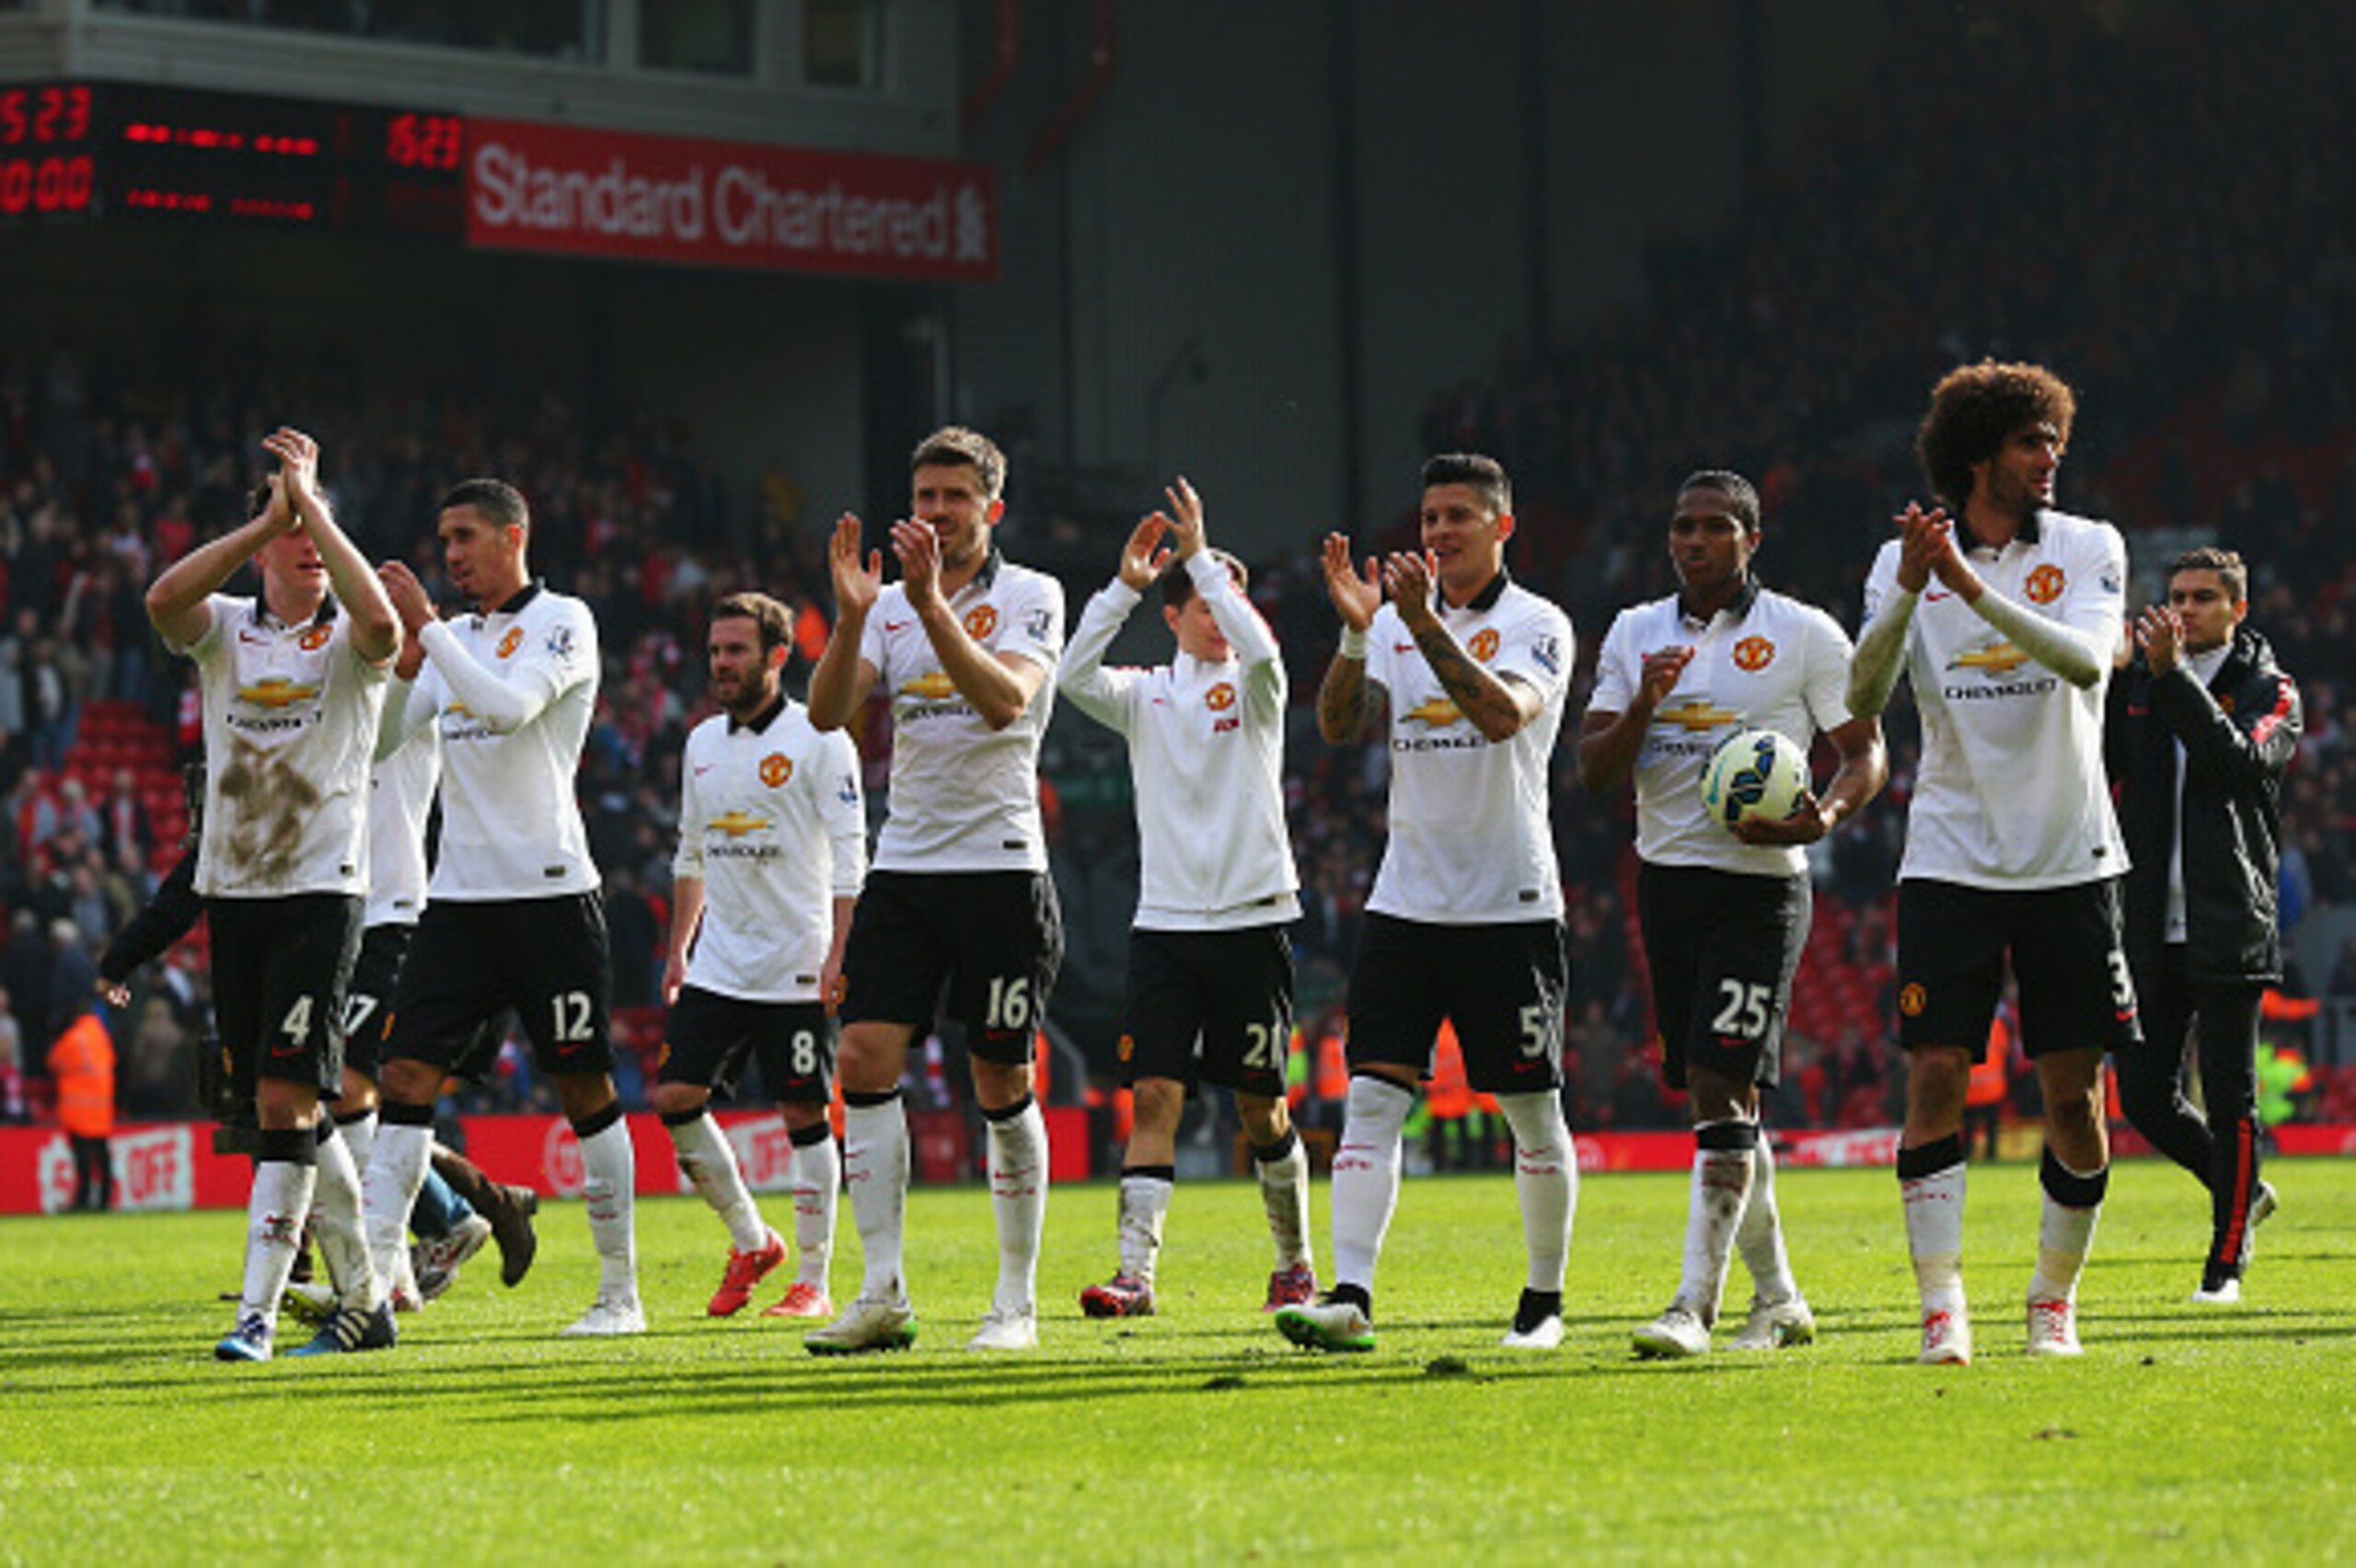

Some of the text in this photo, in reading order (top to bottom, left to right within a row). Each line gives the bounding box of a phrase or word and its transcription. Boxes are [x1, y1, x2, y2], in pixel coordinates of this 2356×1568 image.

[473, 144, 950, 261] Standard Chartered
[282, 995, 314, 1046] 4
[553, 991, 595, 1041] 12
[986, 976, 1030, 1029] 16
[1713, 978, 1773, 1038] 25
[791, 1030, 817, 1074] 8
[1519, 1006, 1546, 1057] 5
